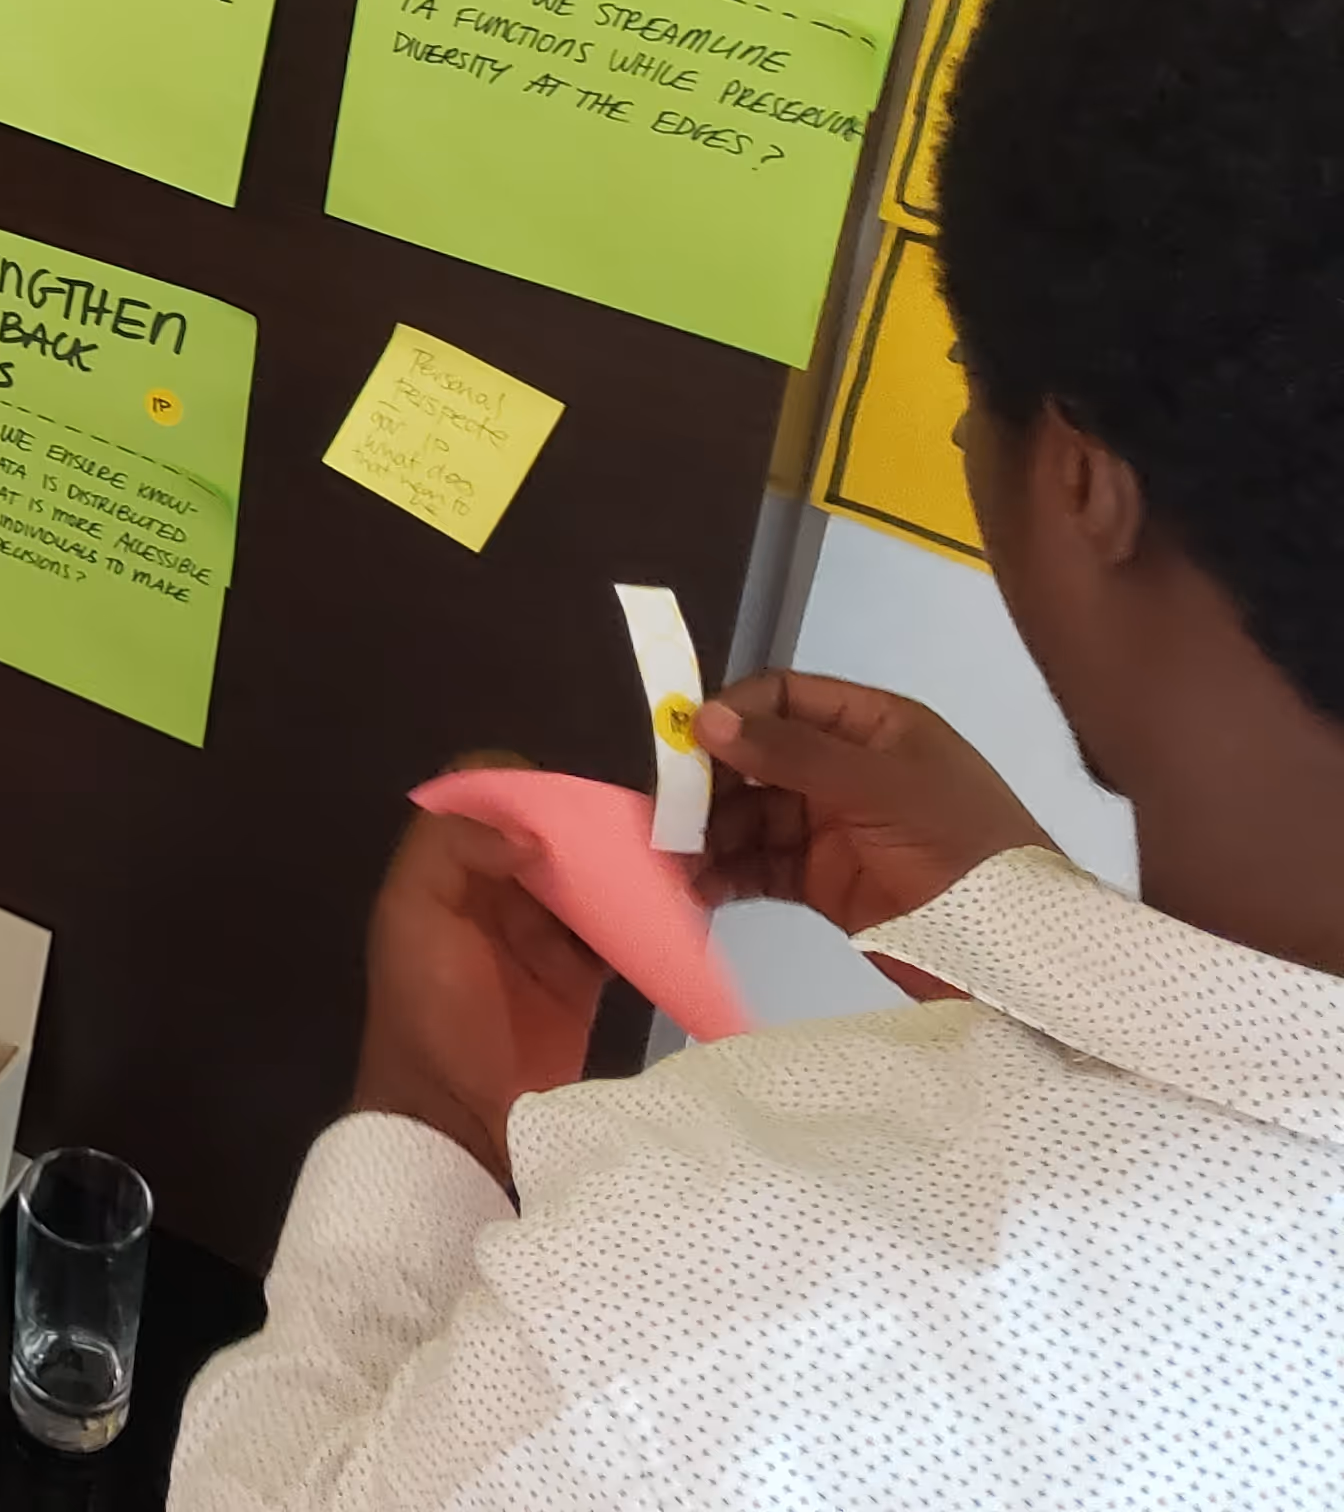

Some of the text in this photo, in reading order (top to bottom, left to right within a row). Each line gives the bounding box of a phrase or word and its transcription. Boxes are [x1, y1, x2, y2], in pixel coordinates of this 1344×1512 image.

[392, 31, 635, 123] DIVERSITY AT THE
[454, 8, 596, 63] FUNCTIONS
[608, 49, 701, 92] WHILE
[594, 3, 793, 74] STREAMLINE
[0, 424, 35, 453] WE
[45, 445, 128, 490] ENSURE
